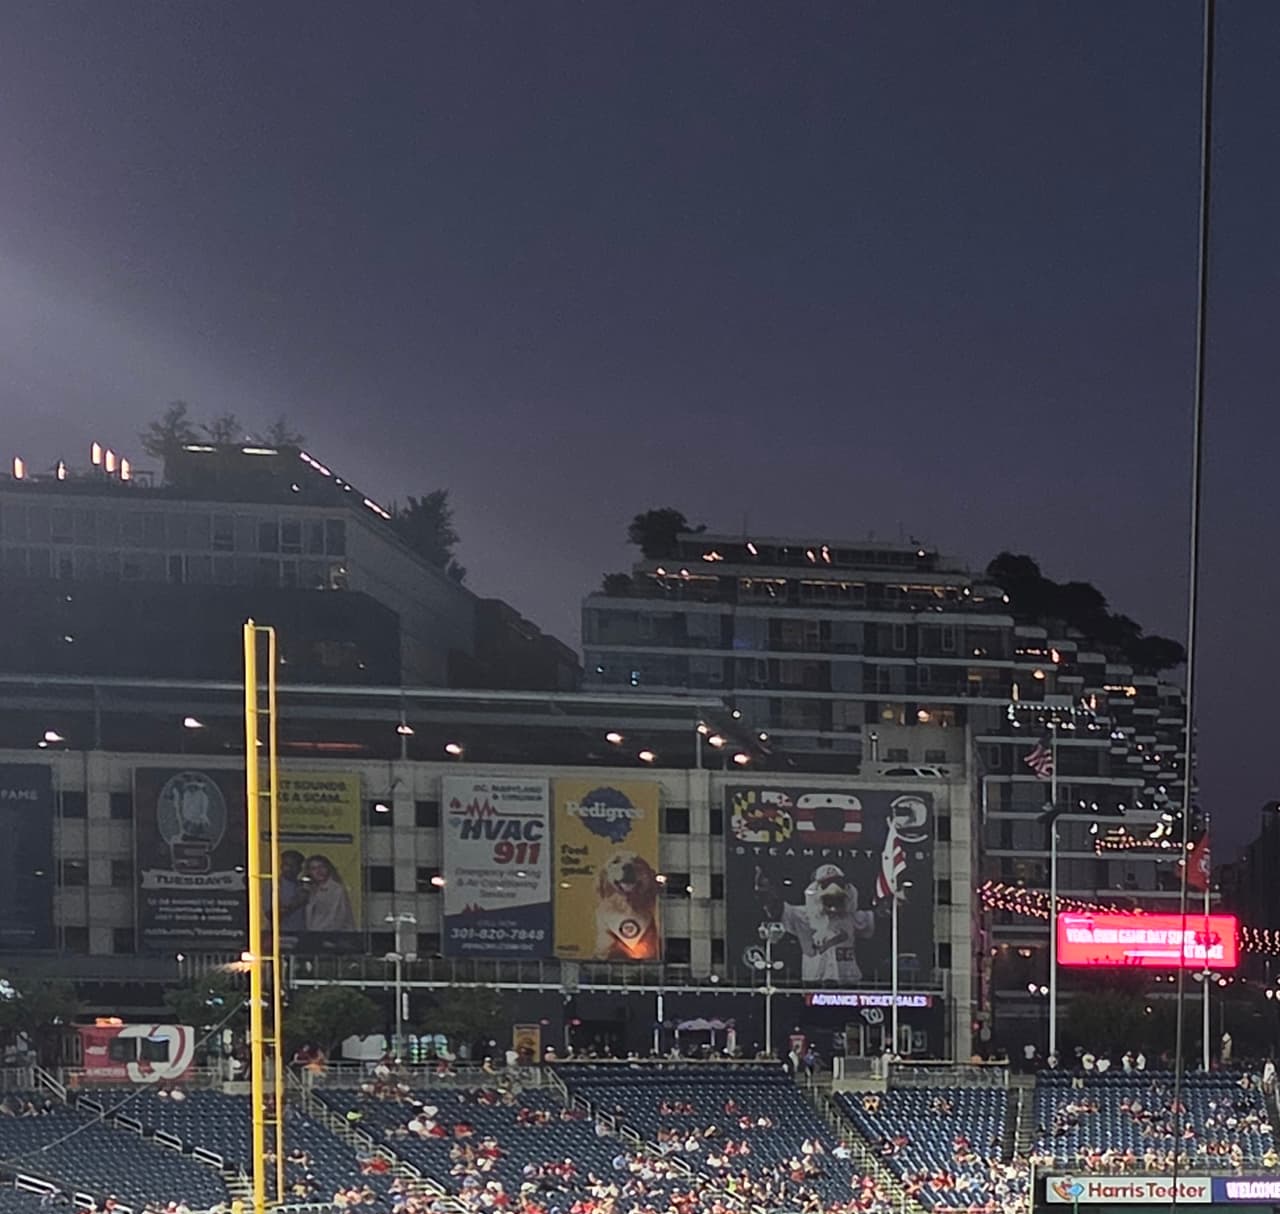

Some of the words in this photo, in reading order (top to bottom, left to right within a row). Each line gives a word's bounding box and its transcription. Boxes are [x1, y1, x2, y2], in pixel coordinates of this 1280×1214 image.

[566, 802, 645, 822] Pedigree
[460, 820, 544, 840] HVAC
[493, 842, 541, 864] 911
[156, 876, 232, 885] TUESDAYS
[812, 995, 858, 1006] ADVANCE
[897, 996, 928, 1007] SALES
[1088, 1183, 1144, 1198] Harris
[1146, 1183, 1206, 1198] Teeter
